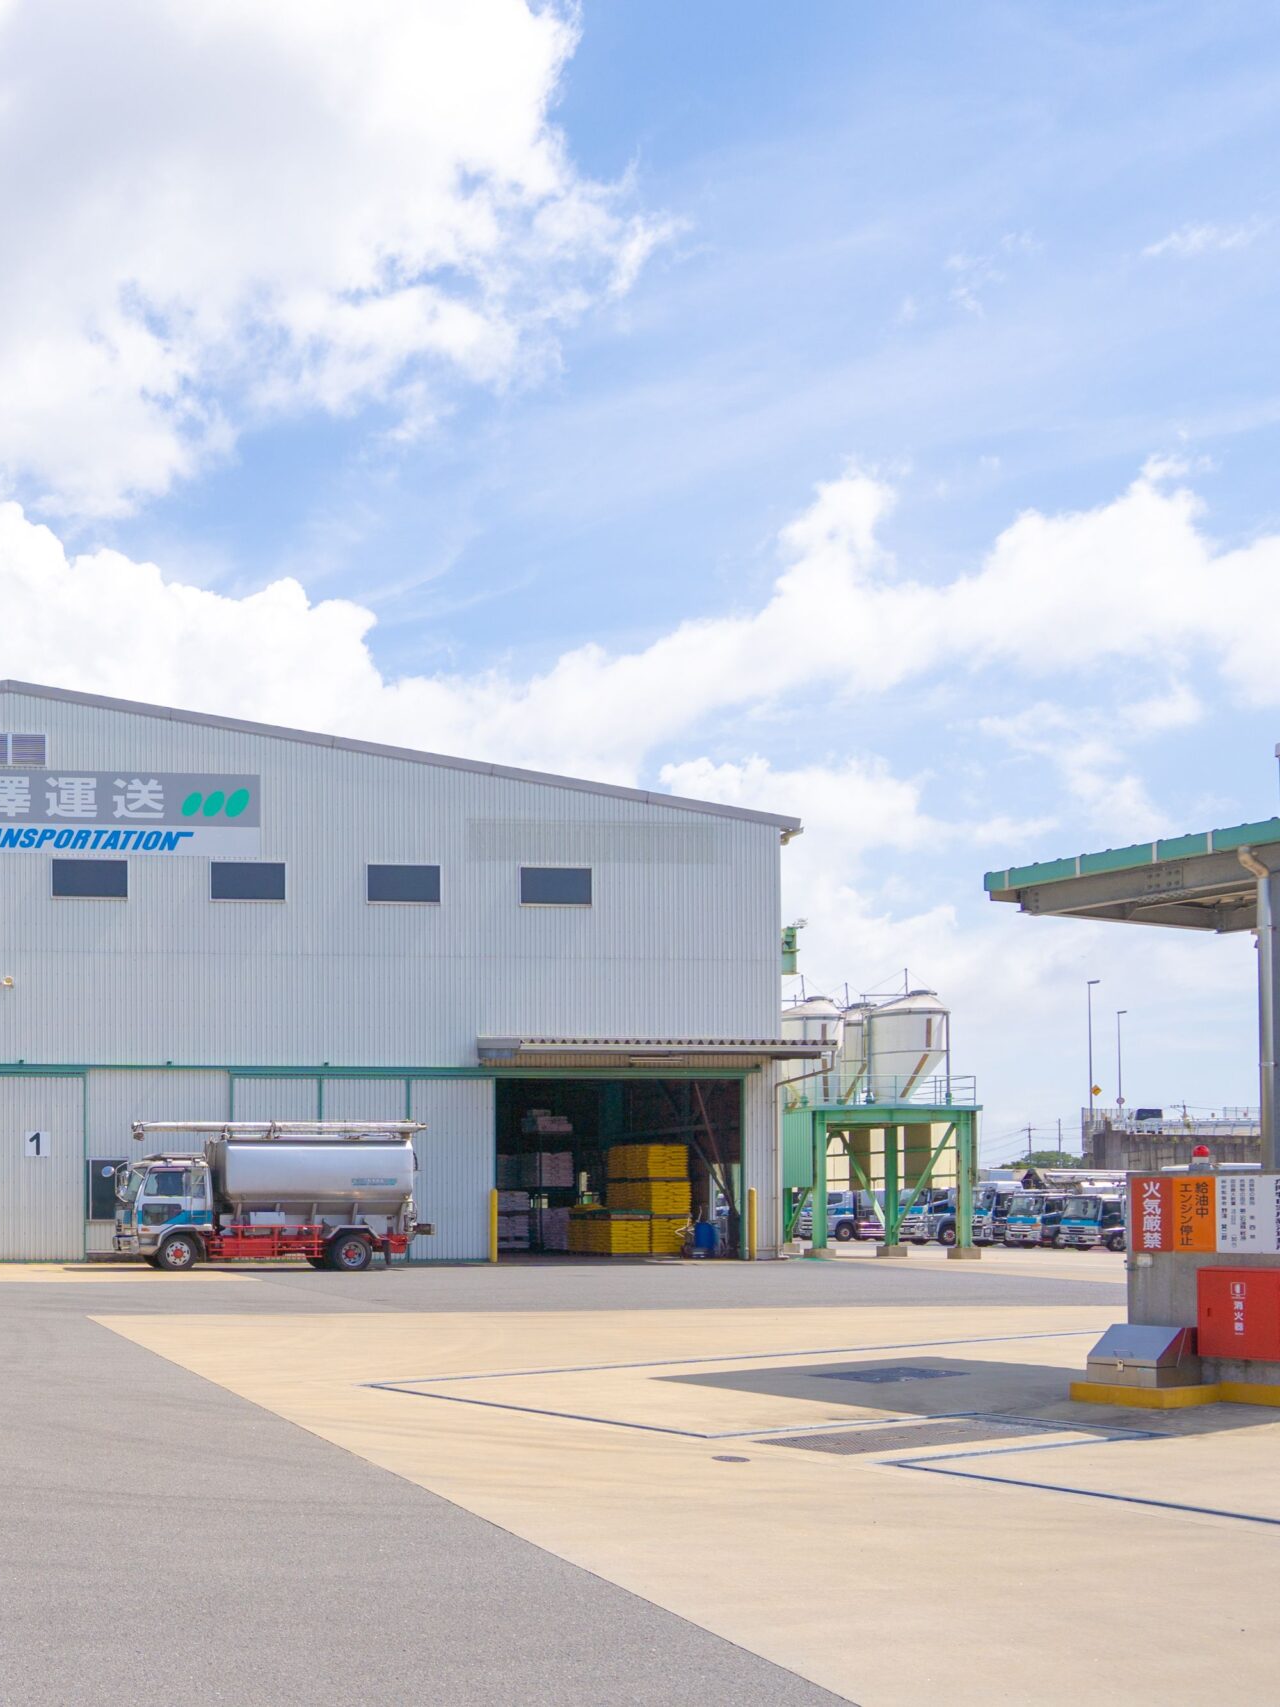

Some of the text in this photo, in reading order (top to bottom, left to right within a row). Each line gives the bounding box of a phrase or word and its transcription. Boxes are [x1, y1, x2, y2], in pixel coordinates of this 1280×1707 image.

[29, 1132, 40, 1155] 1
[1142, 1181, 1162, 1249] 火気厳禁
[1179, 1183, 1193, 1246] エンジン停止
[1195, 1182, 1209, 1218] 給油中
